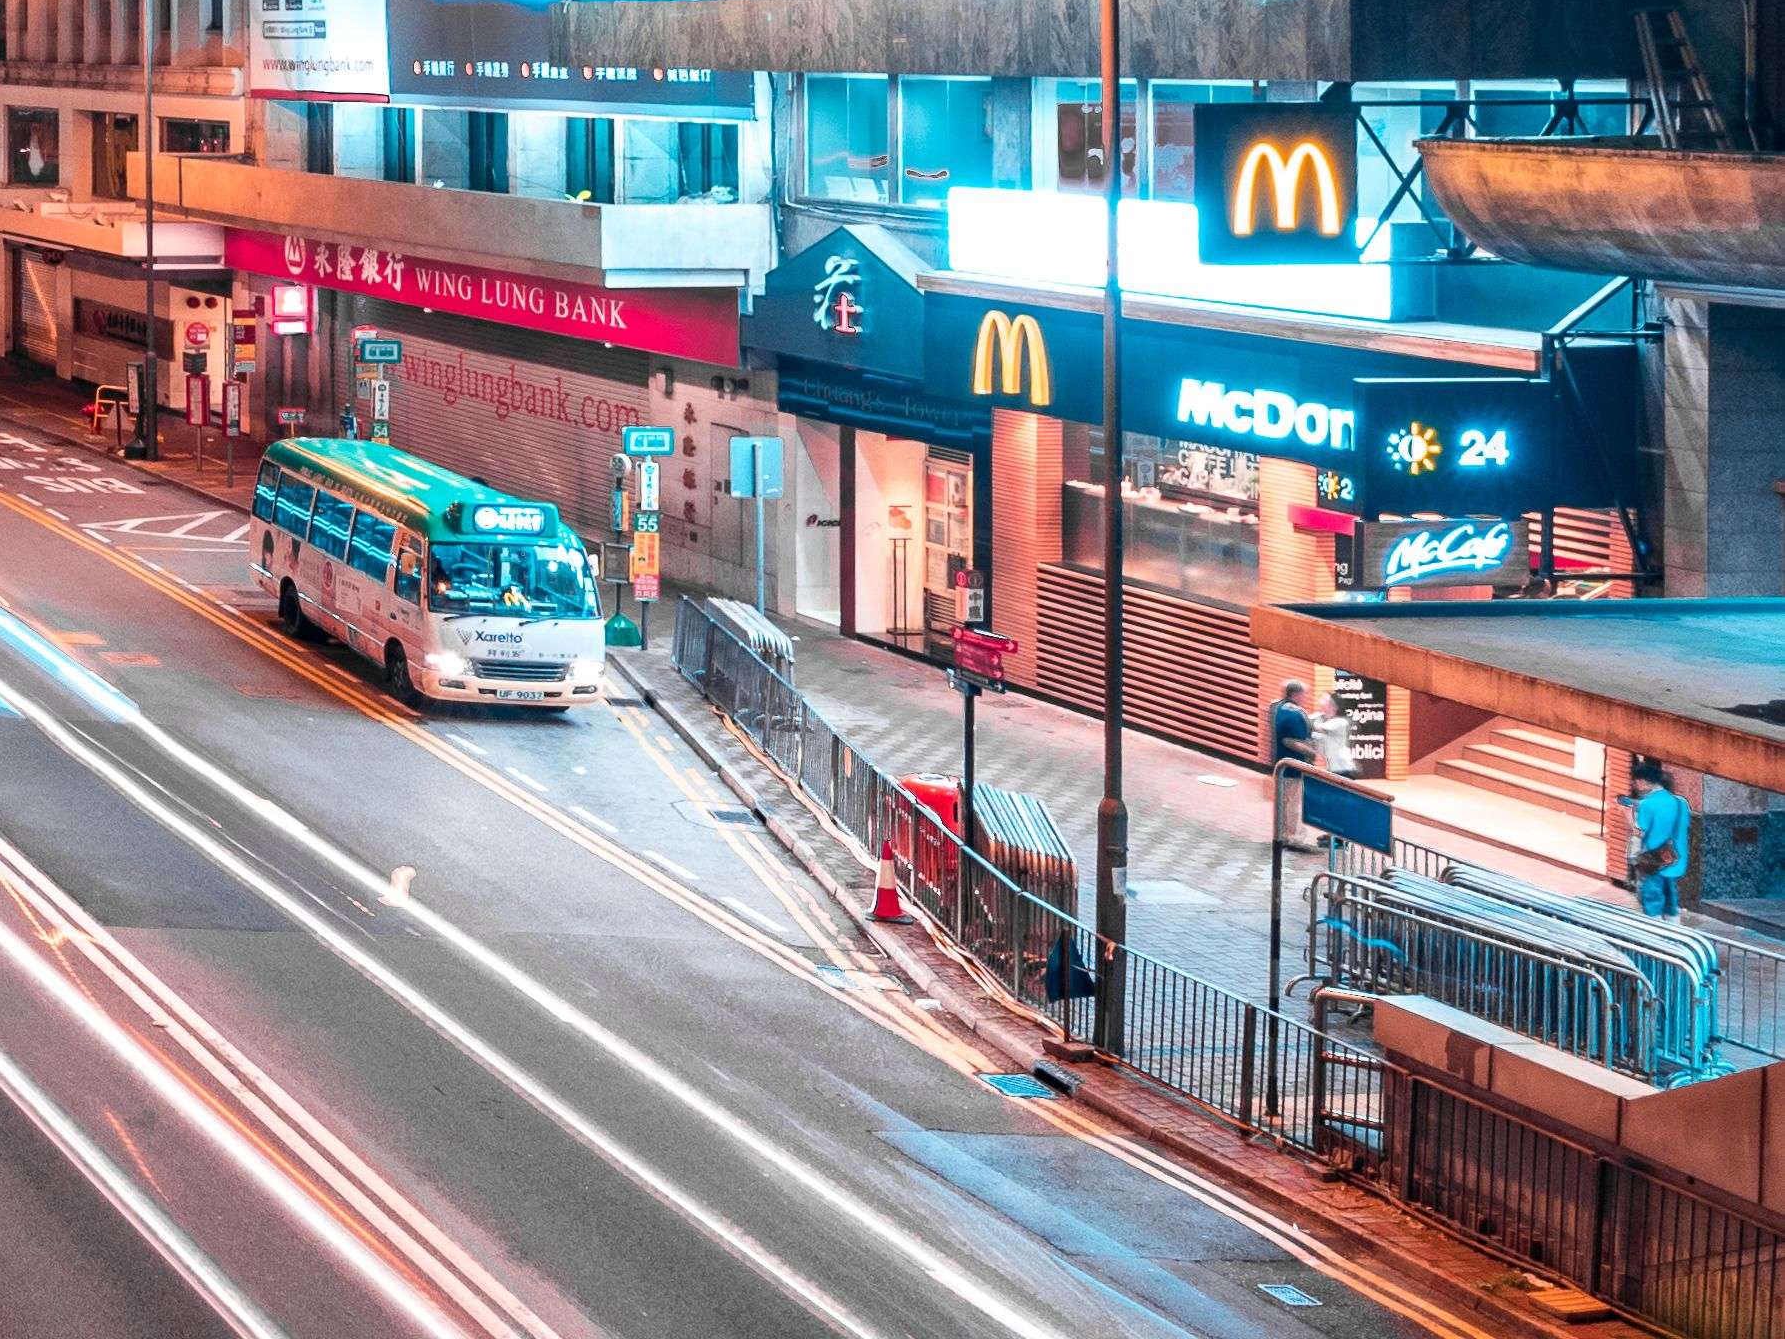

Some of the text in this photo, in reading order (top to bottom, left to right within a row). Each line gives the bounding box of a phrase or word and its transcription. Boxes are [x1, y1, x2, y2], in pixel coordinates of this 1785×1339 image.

[313, 244, 627, 329] 永隆銀行 WING LUNG BANK
[373, 425, 388, 437] 54
[1458, 429, 1511, 466] 24
[637, 517, 659, 532] 55
[475, 630, 523, 644] Xarelto
